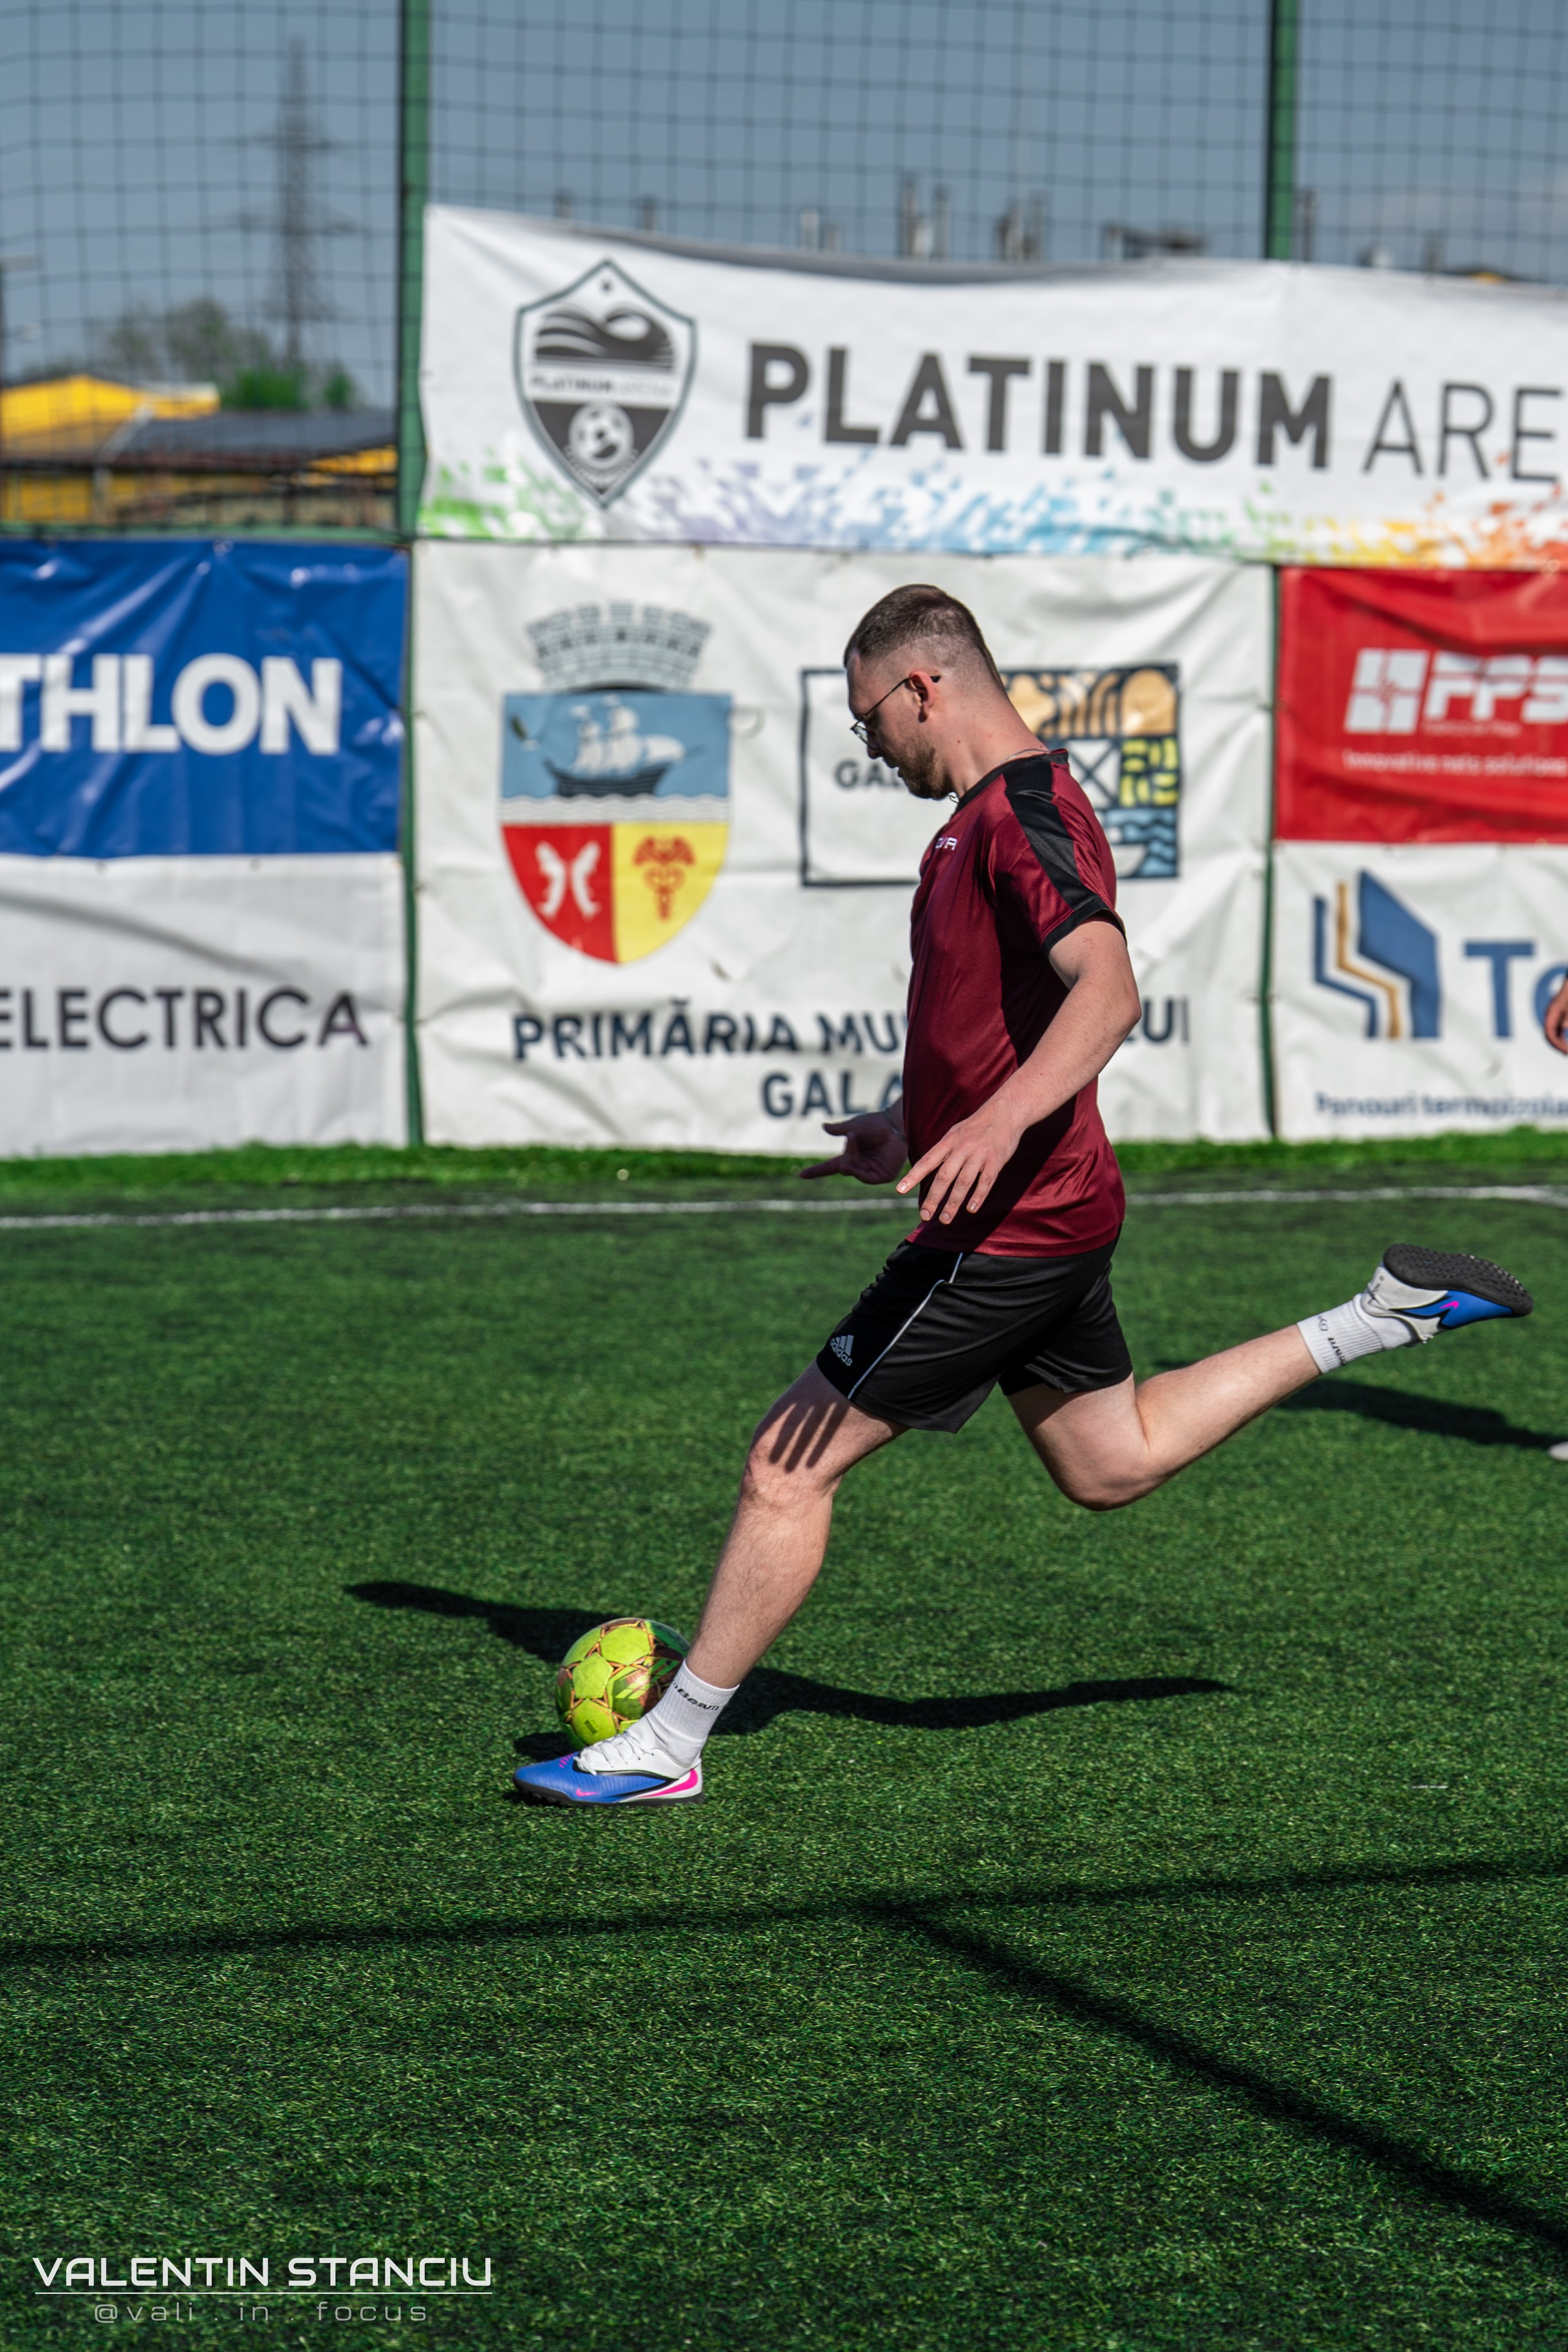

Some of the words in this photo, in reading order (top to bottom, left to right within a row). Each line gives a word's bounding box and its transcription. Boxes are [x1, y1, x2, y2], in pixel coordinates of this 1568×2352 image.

[746, 339, 1331, 470] PLATINUM
[1363, 377, 1563, 483] ARE
[0, 651, 343, 756] THLON
[513, 995, 799, 1061] PRIMĂRIA
[816, 1011, 908, 1055] MU
[1123, 996, 1191, 1046] UI
[831, 1338, 853, 1366] adidas
